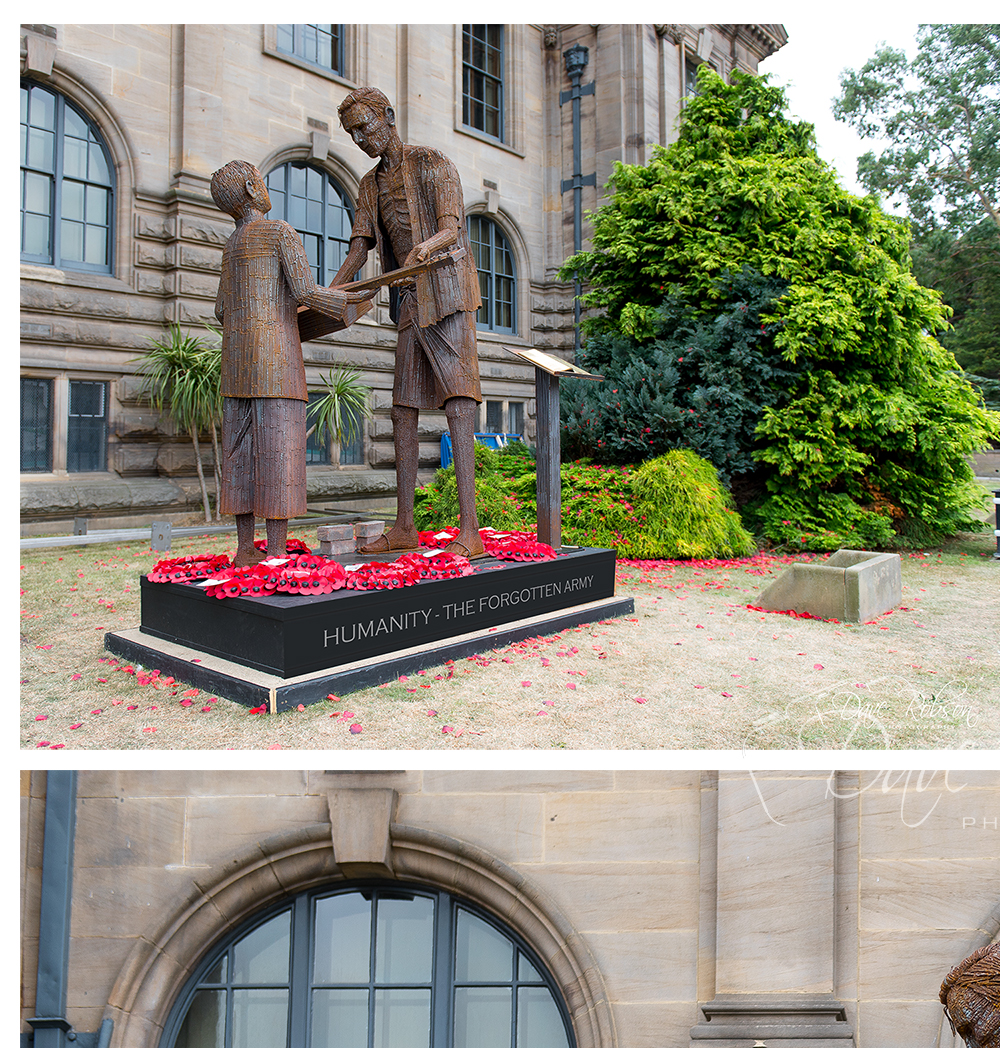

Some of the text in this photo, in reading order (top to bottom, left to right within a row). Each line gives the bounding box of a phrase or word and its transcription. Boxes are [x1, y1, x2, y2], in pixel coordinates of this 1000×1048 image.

[323, 608, 432, 648] HUMANITY
[442, 599, 476, 620] THE
[479, 581, 562, 613] FORGOTTEN
[563, 575, 594, 594] ARMY
